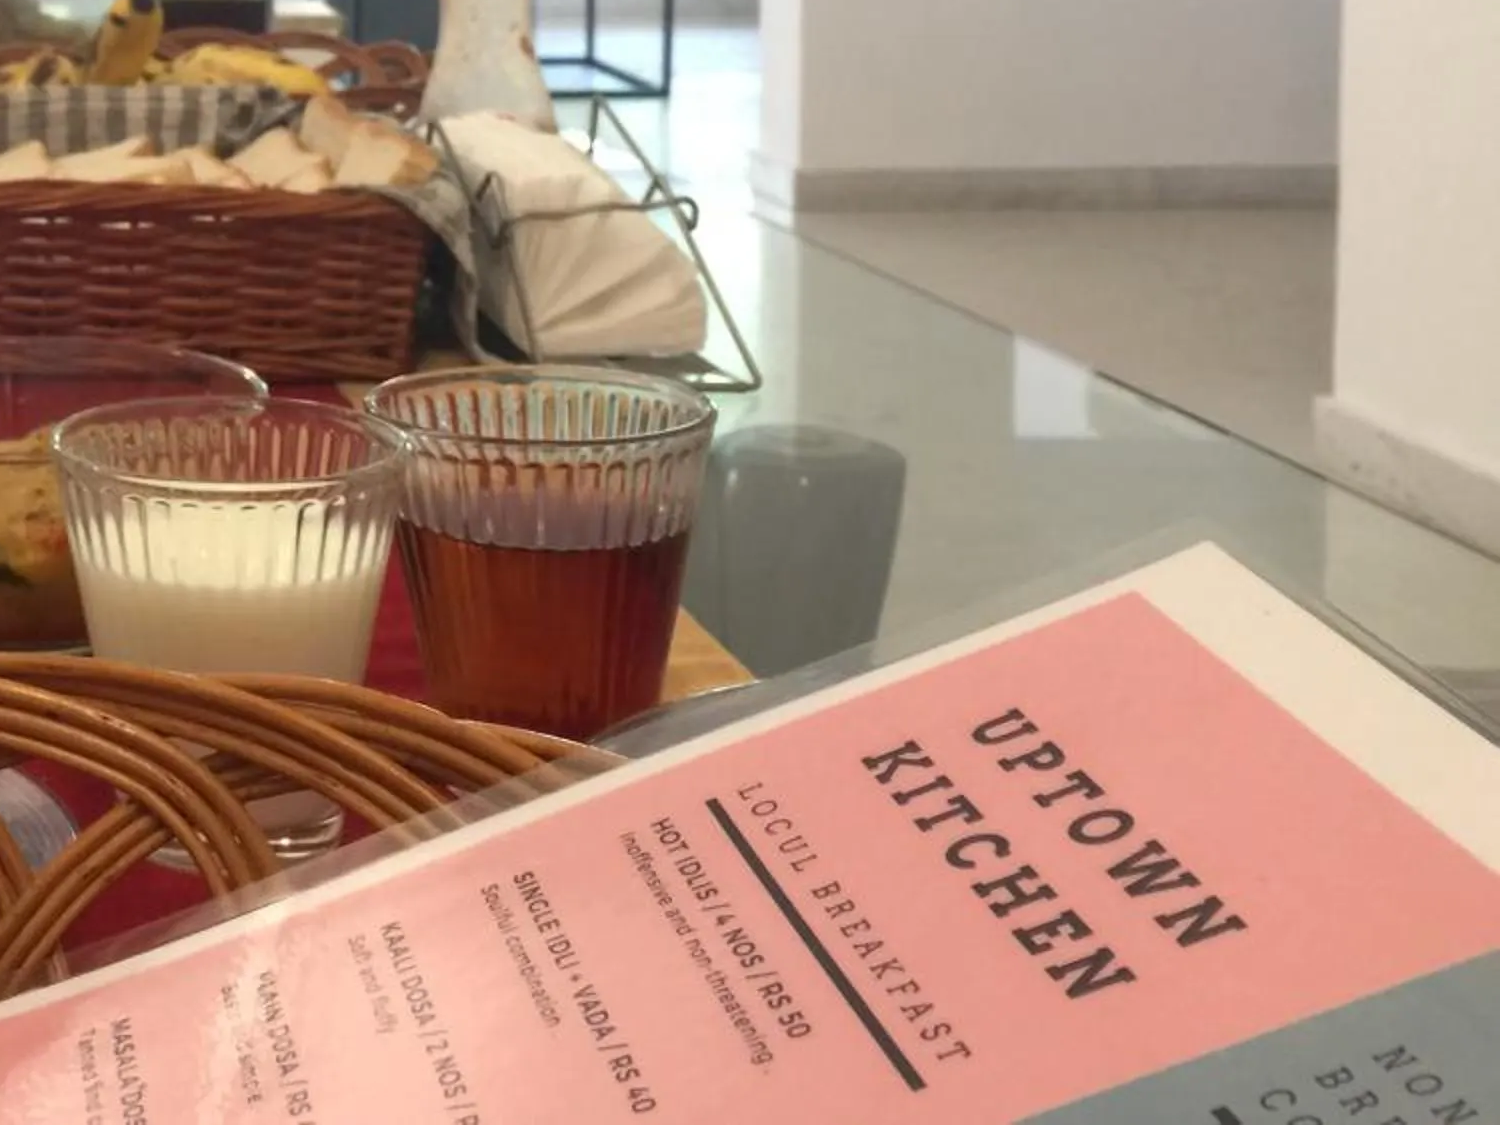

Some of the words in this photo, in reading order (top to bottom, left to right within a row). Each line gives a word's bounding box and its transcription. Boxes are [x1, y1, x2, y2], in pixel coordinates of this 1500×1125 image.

[651, 817, 690, 854] HOT
[971, 708, 1248, 948] UPTOWN
[675, 856, 718, 902] IDLIS
[861, 740, 1137, 1000] KITCHEN
[665, 907, 697, 936] and
[716, 913, 736, 926] 4
[738, 782, 817, 872] LOCUL
[812, 880, 971, 1061] BREAKFAST
[381, 921, 417, 974] KAALI
[722, 927, 764, 969] NOS
[401, 975, 435, 1027] DOSA
[513, 871, 561, 934] SINGLE
[545, 934, 580, 970] IDLI
[573, 983, 616, 1041] VADA
[608, 1054, 641, 1083] RS
[627, 1087, 656, 1114] 40
[758, 982, 792, 1010] RS
[425, 1039, 448, 1054] 2
[778, 1010, 812, 1039] 50
[111, 1017, 140, 1090] MASALA
[268, 1024, 299, 1077] DOSA
[286, 1090, 311, 1116] RS
[433, 1055, 467, 1099] NOS
